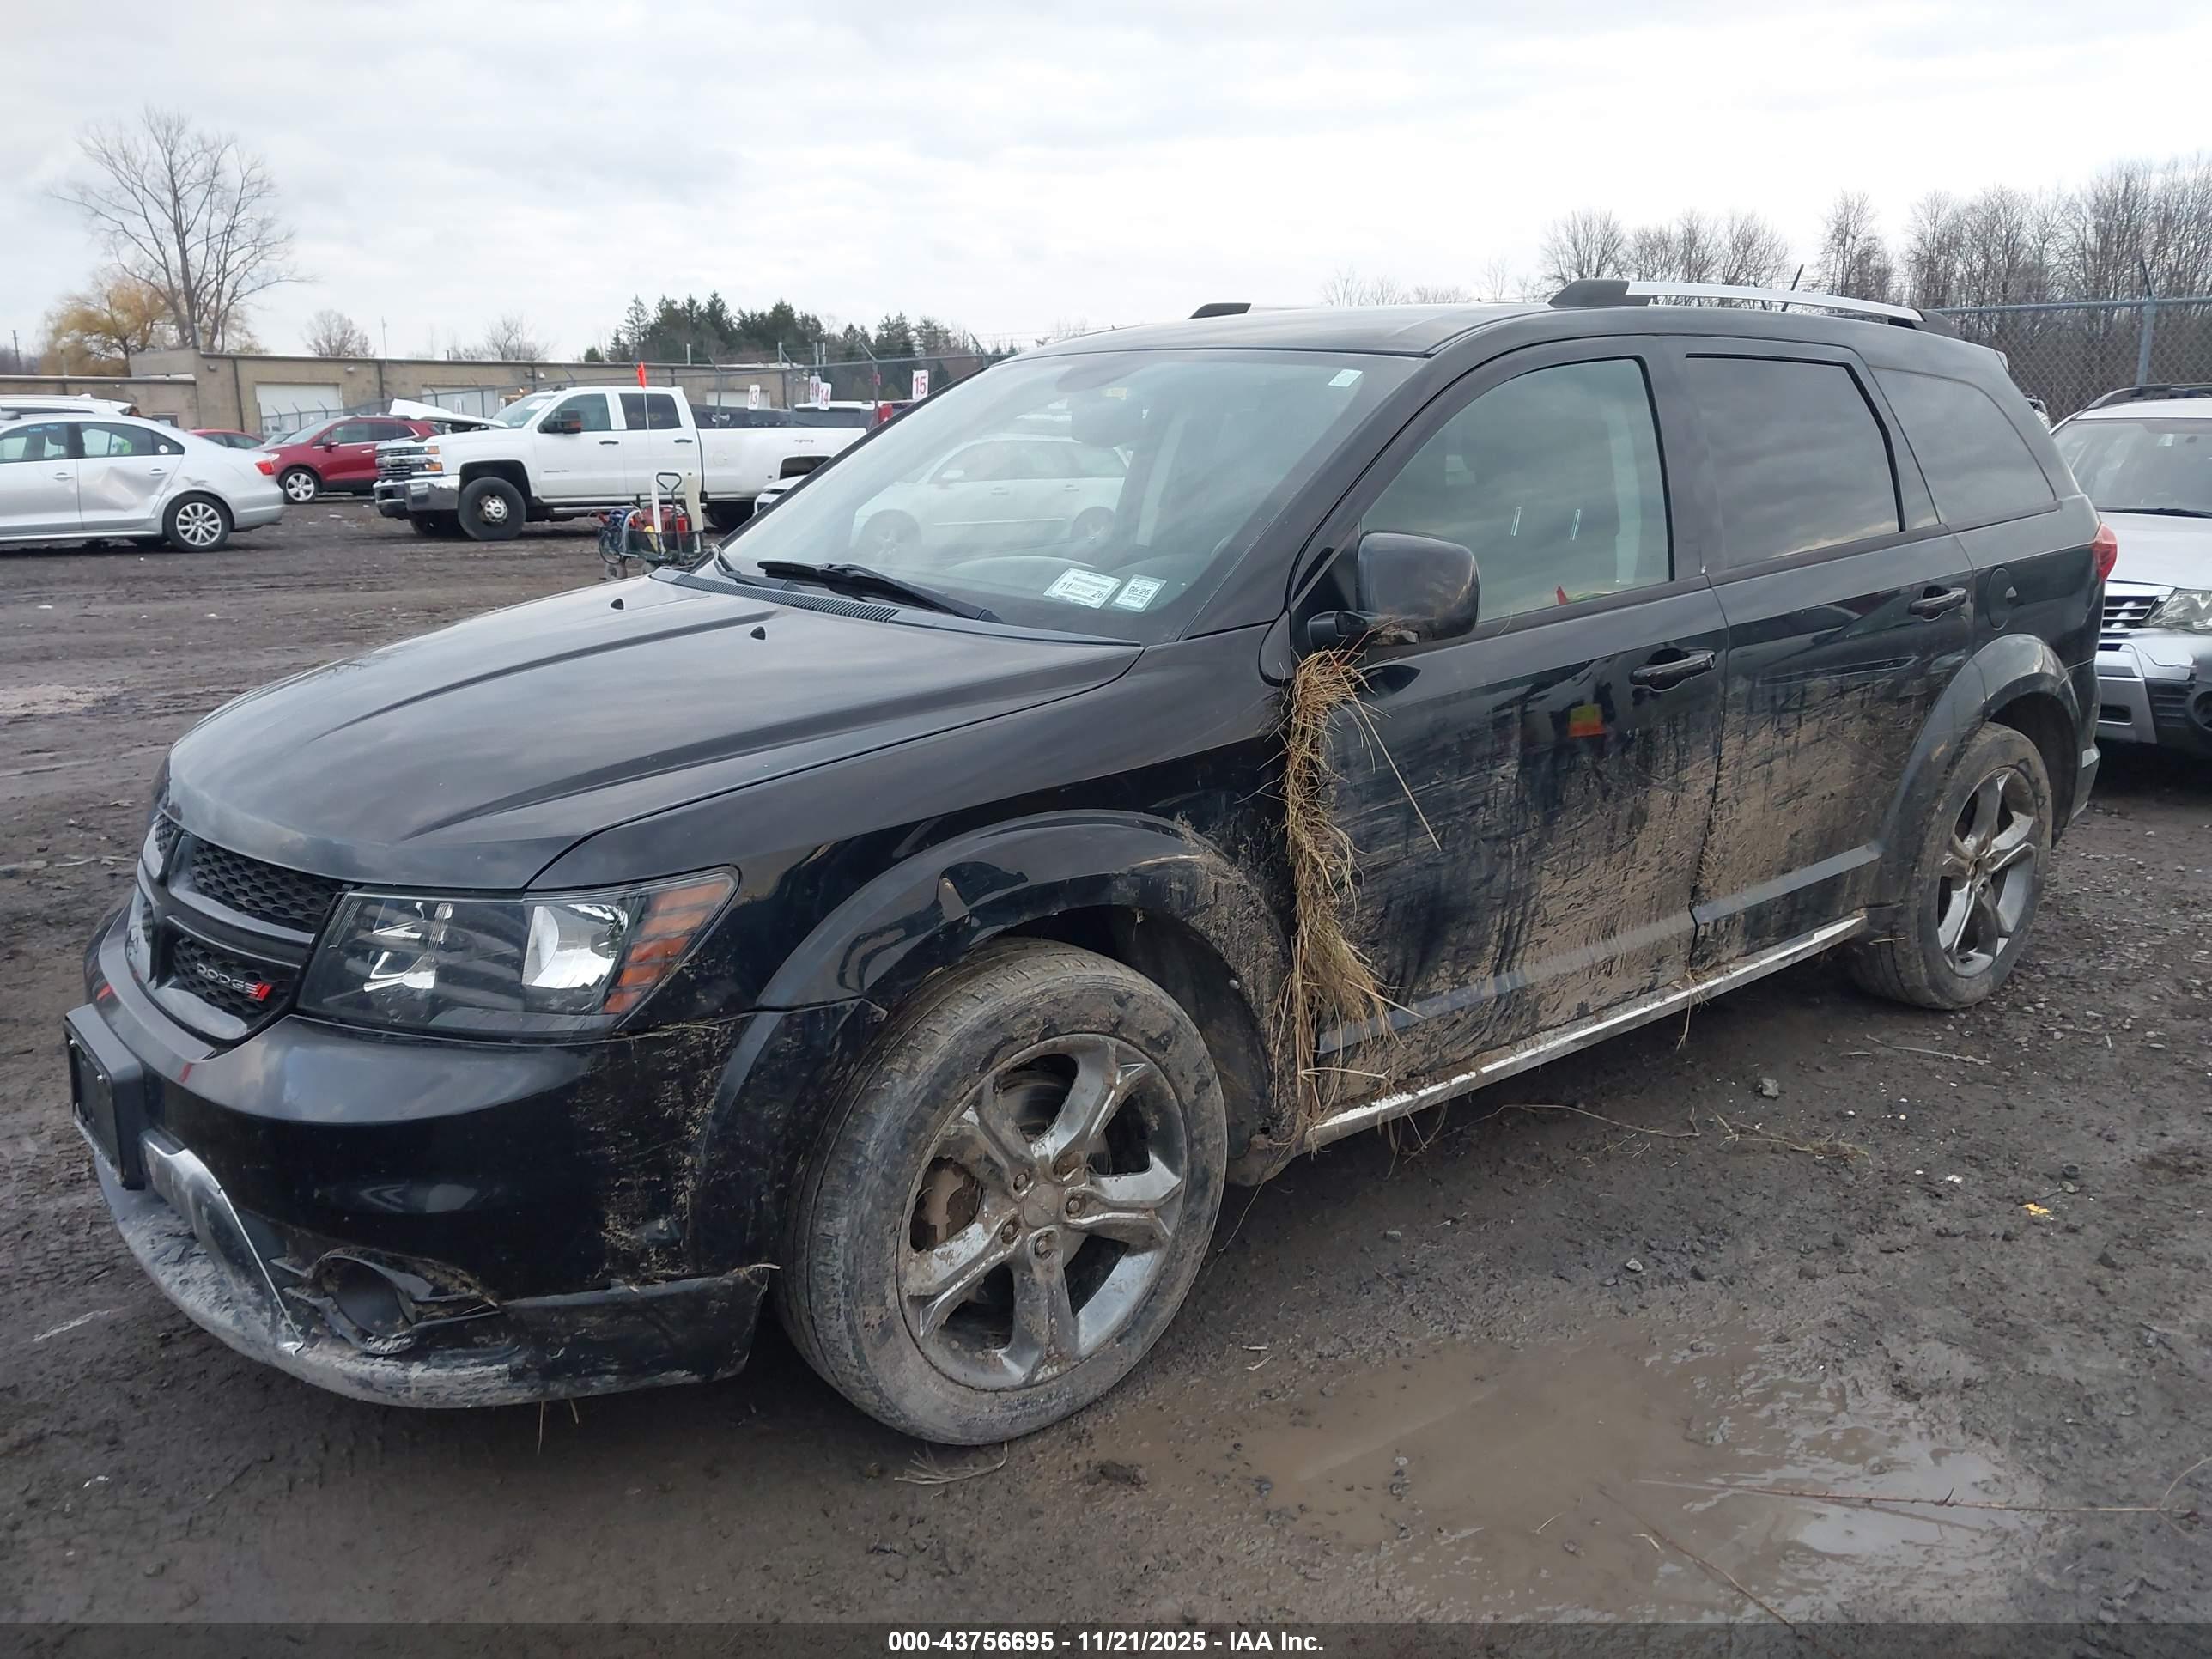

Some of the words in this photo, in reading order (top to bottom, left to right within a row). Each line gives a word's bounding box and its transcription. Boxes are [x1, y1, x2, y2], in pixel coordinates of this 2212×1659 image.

[914, 376, 927, 395] 15
[750, 389, 758, 405] 13
[820, 388, 830, 405] 14
[1091, 590, 1106, 599] 26
[197, 963, 258, 995] DODGE
